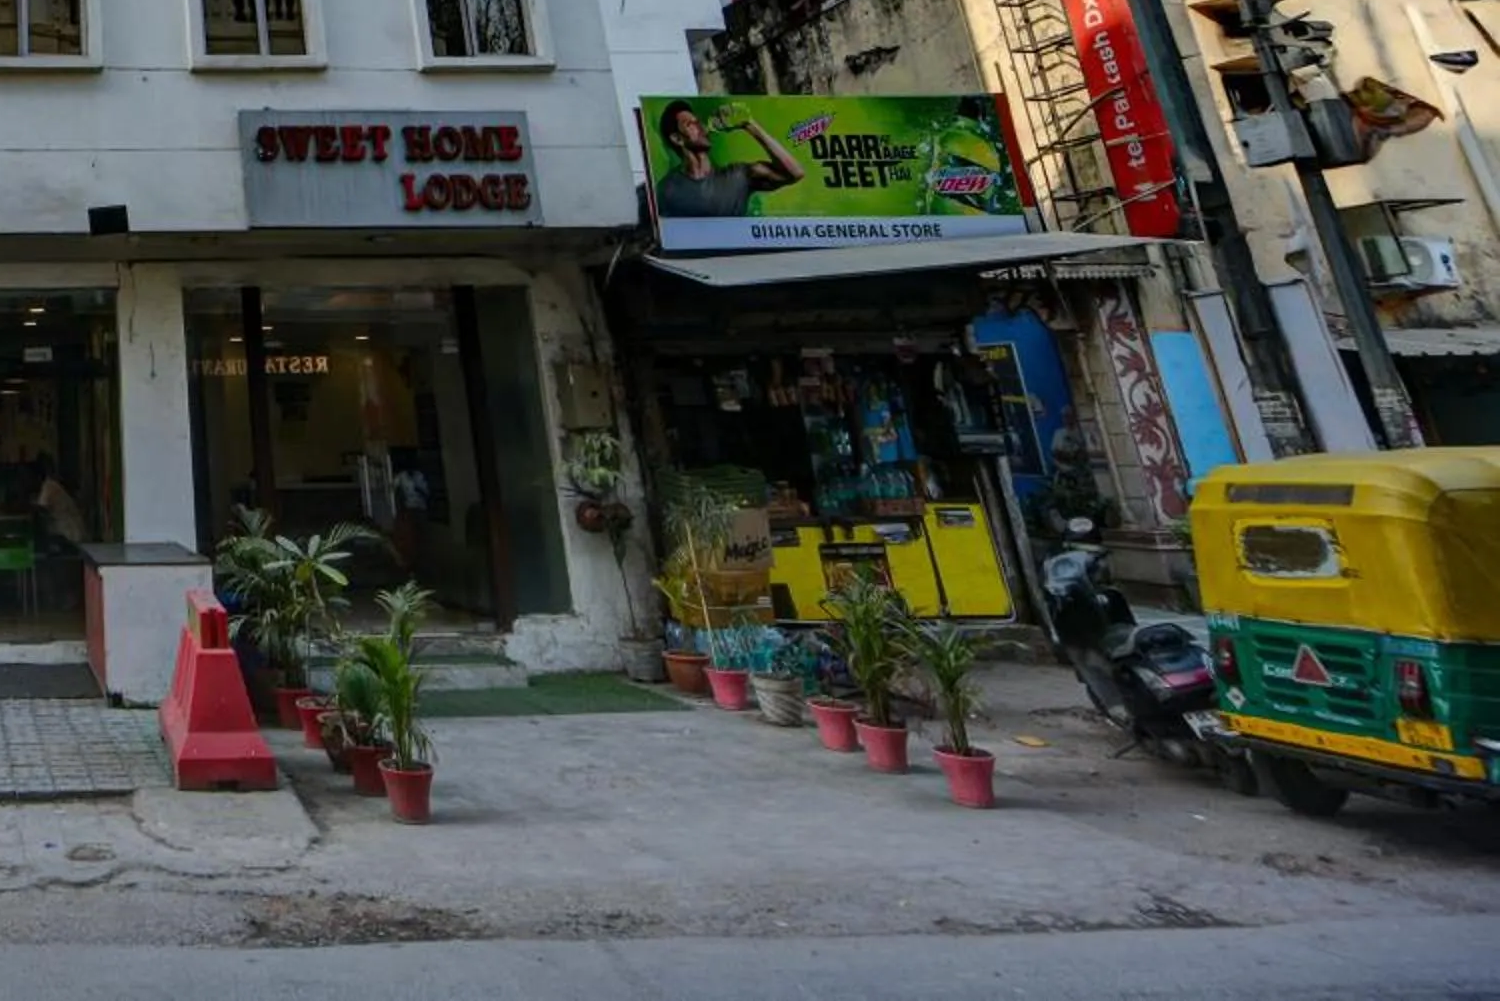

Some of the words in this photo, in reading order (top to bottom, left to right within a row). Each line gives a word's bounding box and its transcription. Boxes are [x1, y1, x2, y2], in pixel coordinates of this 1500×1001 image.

[256, 125, 391, 162] SWEET
[401, 126, 523, 162] HOME
[810, 134, 882, 159] DARR
[822, 161, 898, 188] JEET
[400, 172, 532, 212] LODGE
[815, 225, 888, 239] GENERAL
[891, 223, 942, 238] STORE
